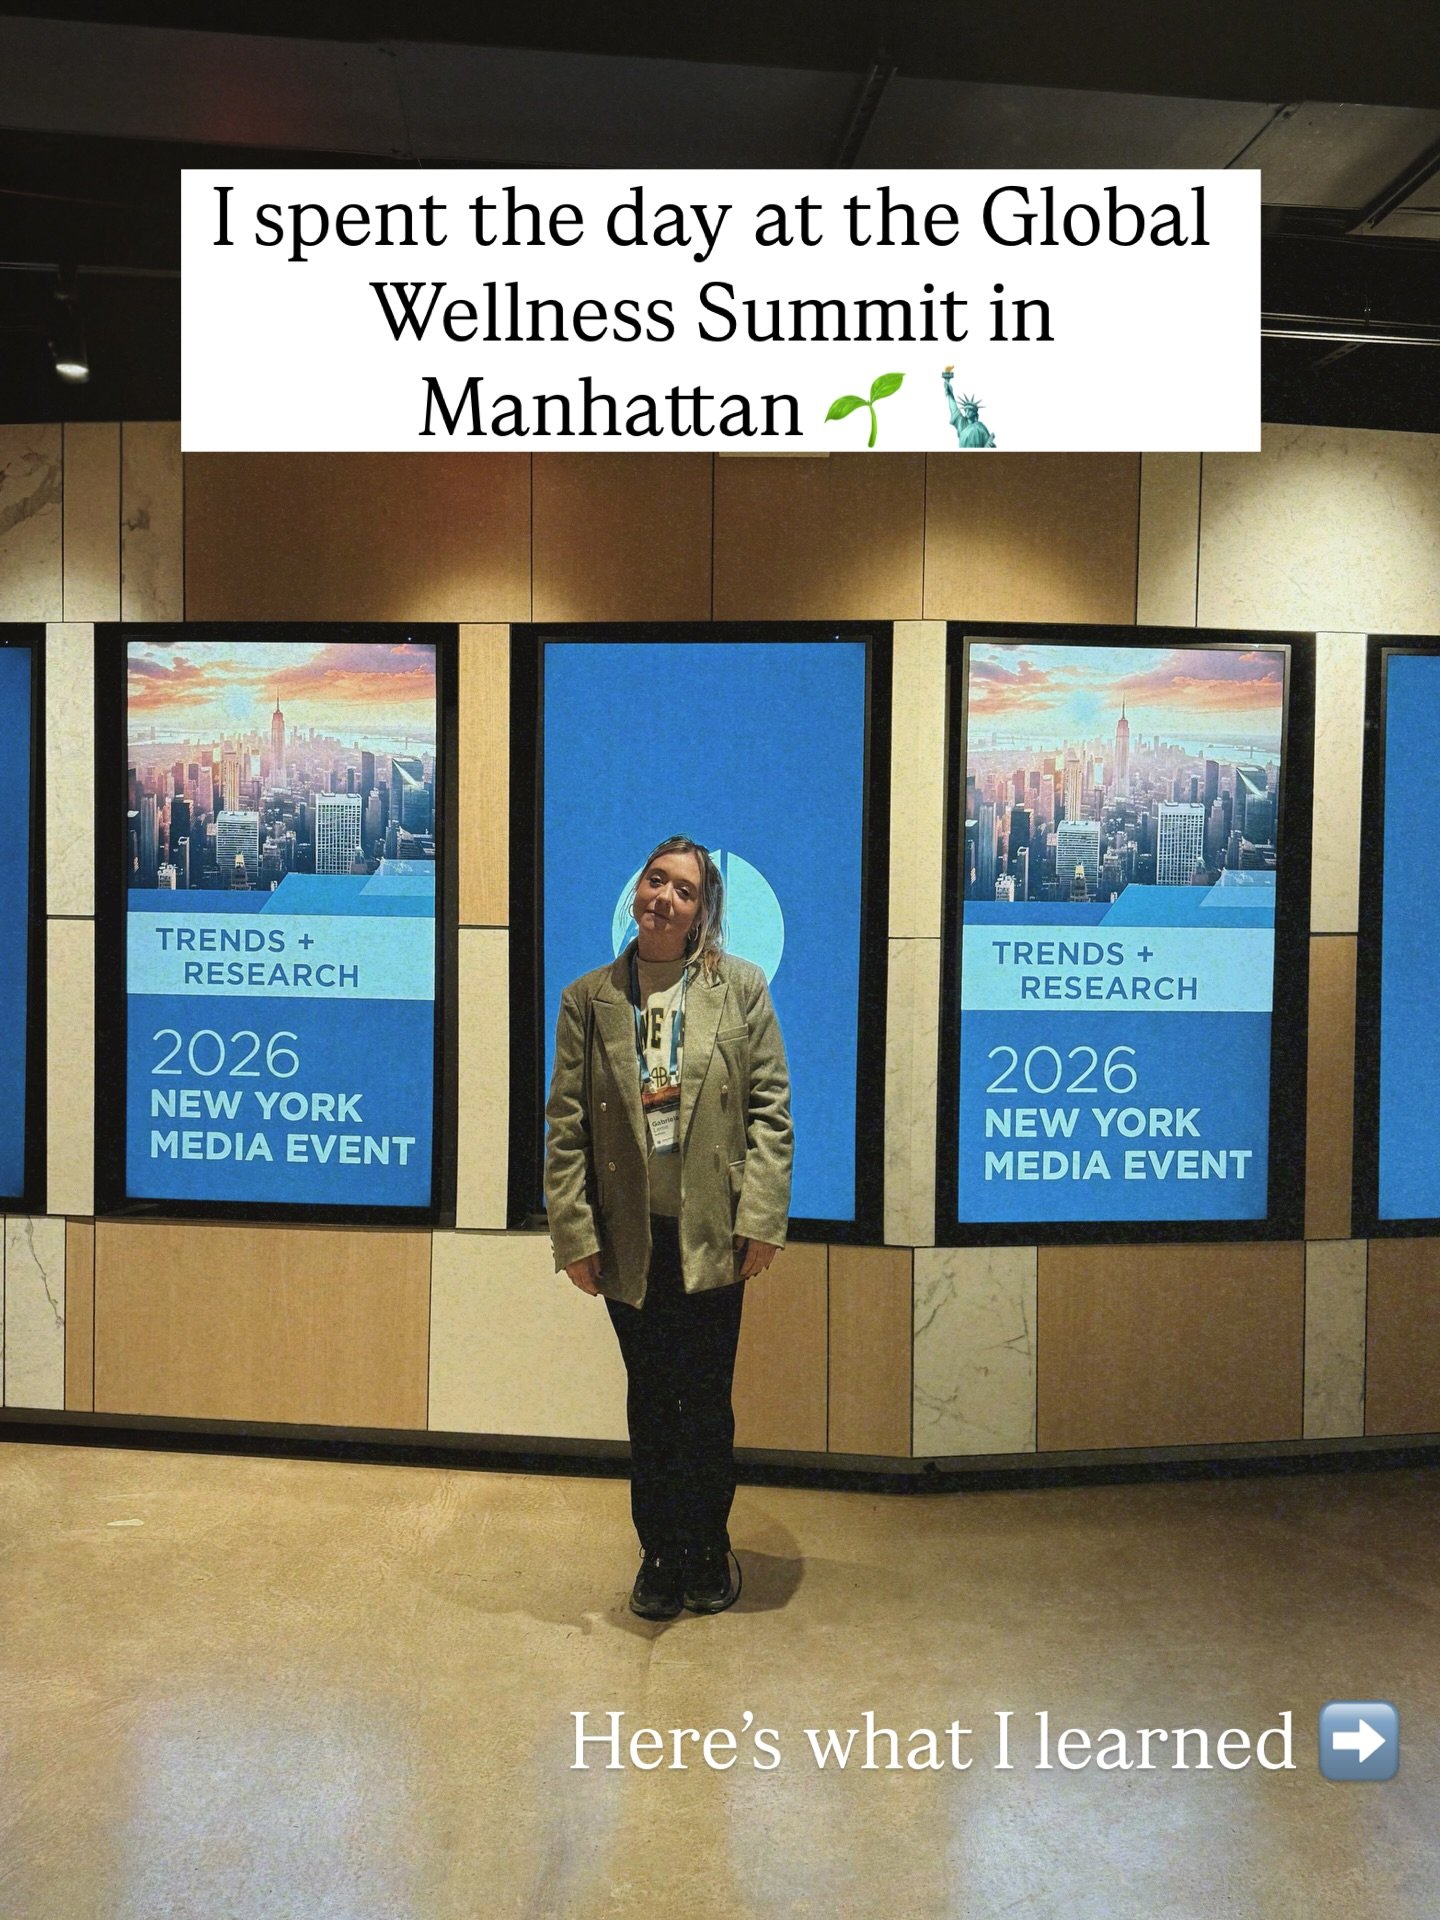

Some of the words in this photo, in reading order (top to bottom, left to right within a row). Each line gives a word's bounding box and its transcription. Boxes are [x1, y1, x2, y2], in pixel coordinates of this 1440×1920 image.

[155, 927, 286, 953] TRENDS
[298, 933, 315, 950] +
[992, 941, 1125, 966] TRENDS
[1137, 945, 1154, 963] +
[184, 961, 359, 988] RESEARCH
[1021, 975, 1198, 1001] RESEARCH
[151, 1028, 300, 1079] 2026
[986, 1045, 1138, 1094] 2026
[151, 1088, 243, 1120] NEW
[254, 1091, 364, 1123] YORK
[985, 1107, 1080, 1138] NEW
[1091, 1107, 1201, 1138] YORK
[151, 1130, 274, 1162] MEDIA
[286, 1133, 416, 1166] EVENT
[984, 1151, 1111, 1181] MEDIA
[1124, 1150, 1253, 1180] EVENT
